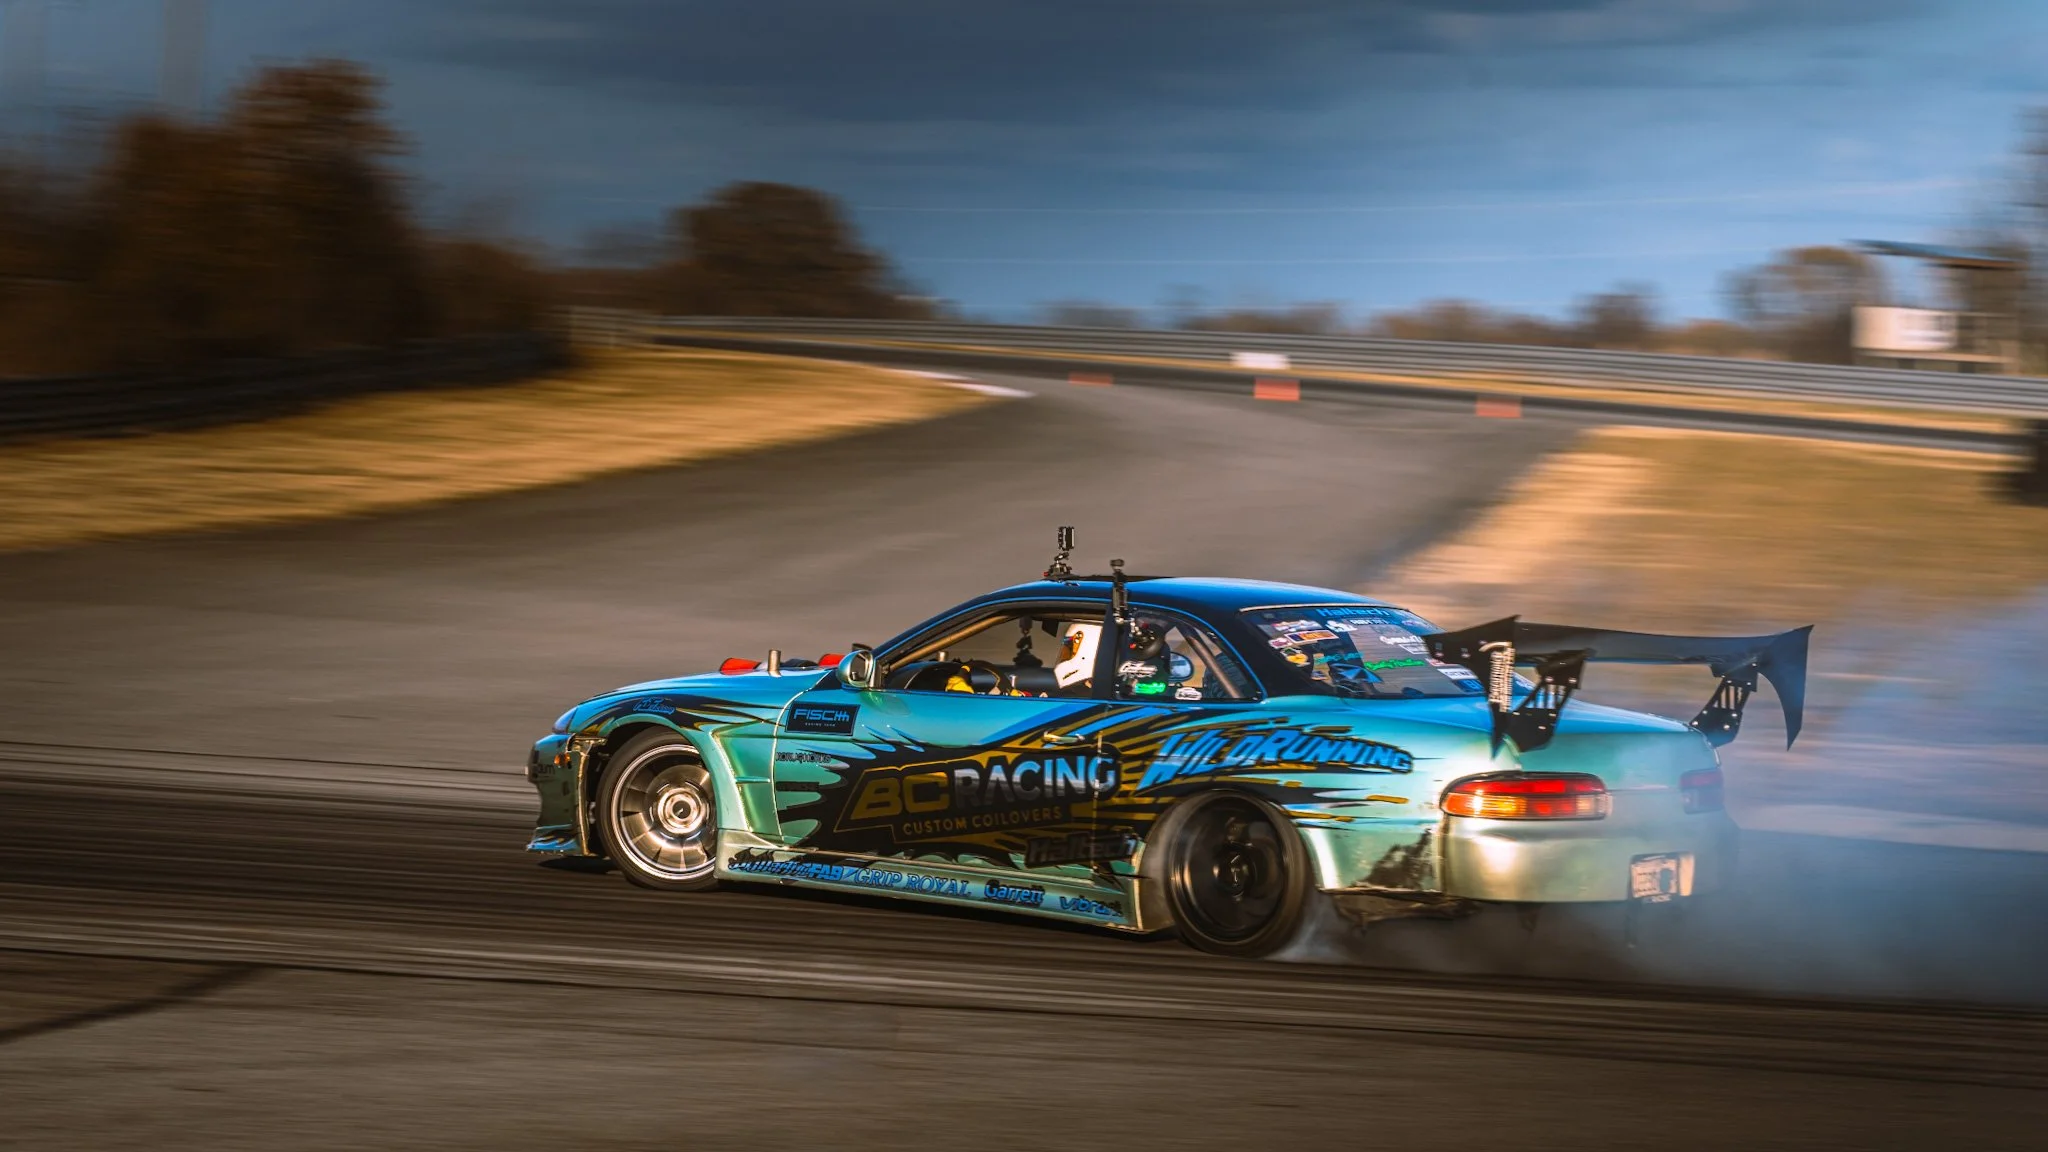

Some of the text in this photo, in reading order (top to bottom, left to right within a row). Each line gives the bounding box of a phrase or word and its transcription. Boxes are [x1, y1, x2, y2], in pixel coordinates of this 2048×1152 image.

[850, 755, 1116, 820] BC RACING
[902, 806, 1063, 836] CUSTOM COILOVERS
[855, 868, 972, 897] GRIP ROYAL
[983, 880, 1046, 906] Garrett
